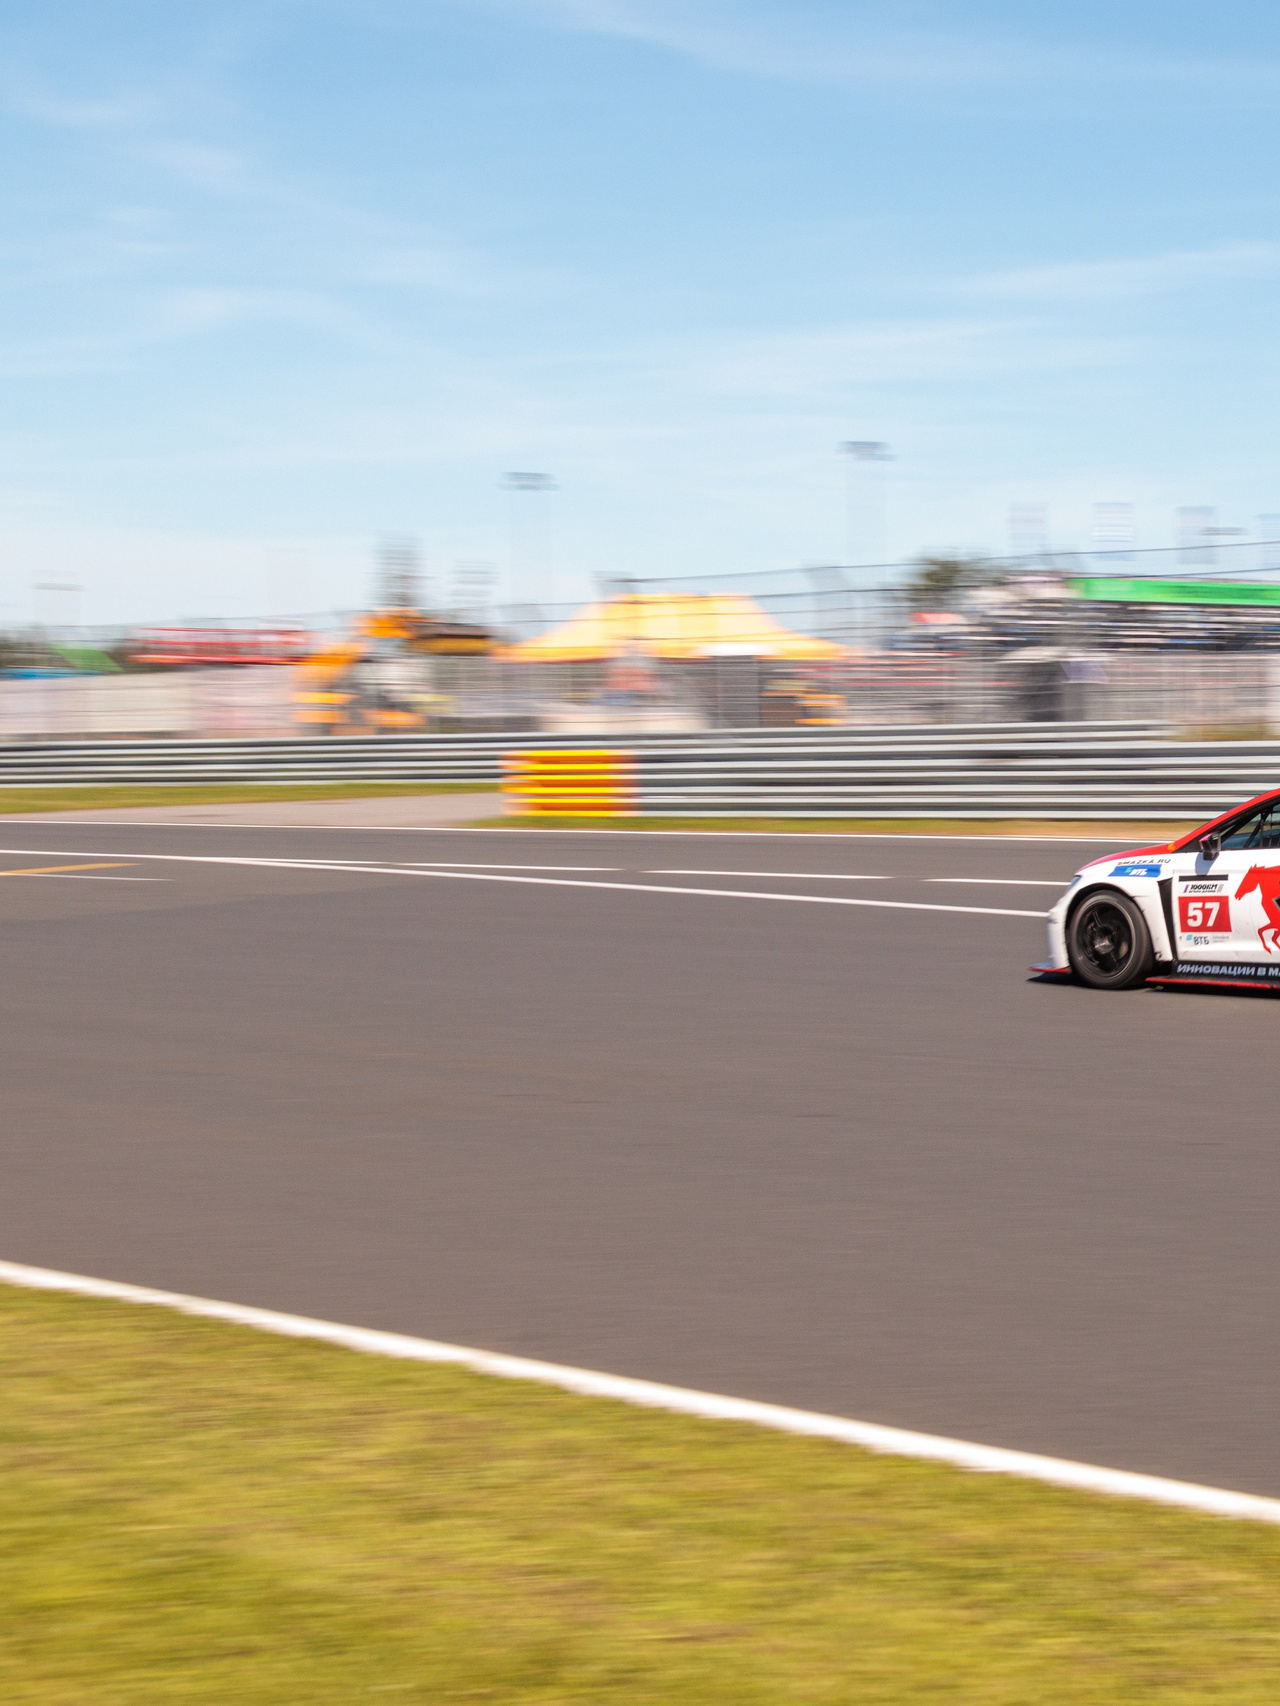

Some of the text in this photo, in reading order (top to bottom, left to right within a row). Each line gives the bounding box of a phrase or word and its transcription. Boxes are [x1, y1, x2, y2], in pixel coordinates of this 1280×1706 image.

[1187, 901, 1221, 928] 57
[1193, 936, 1210, 945] ВТБ
[1177, 964, 1255, 976] ИННОВАЦИИ
[1256, 967, 1267, 976] В
